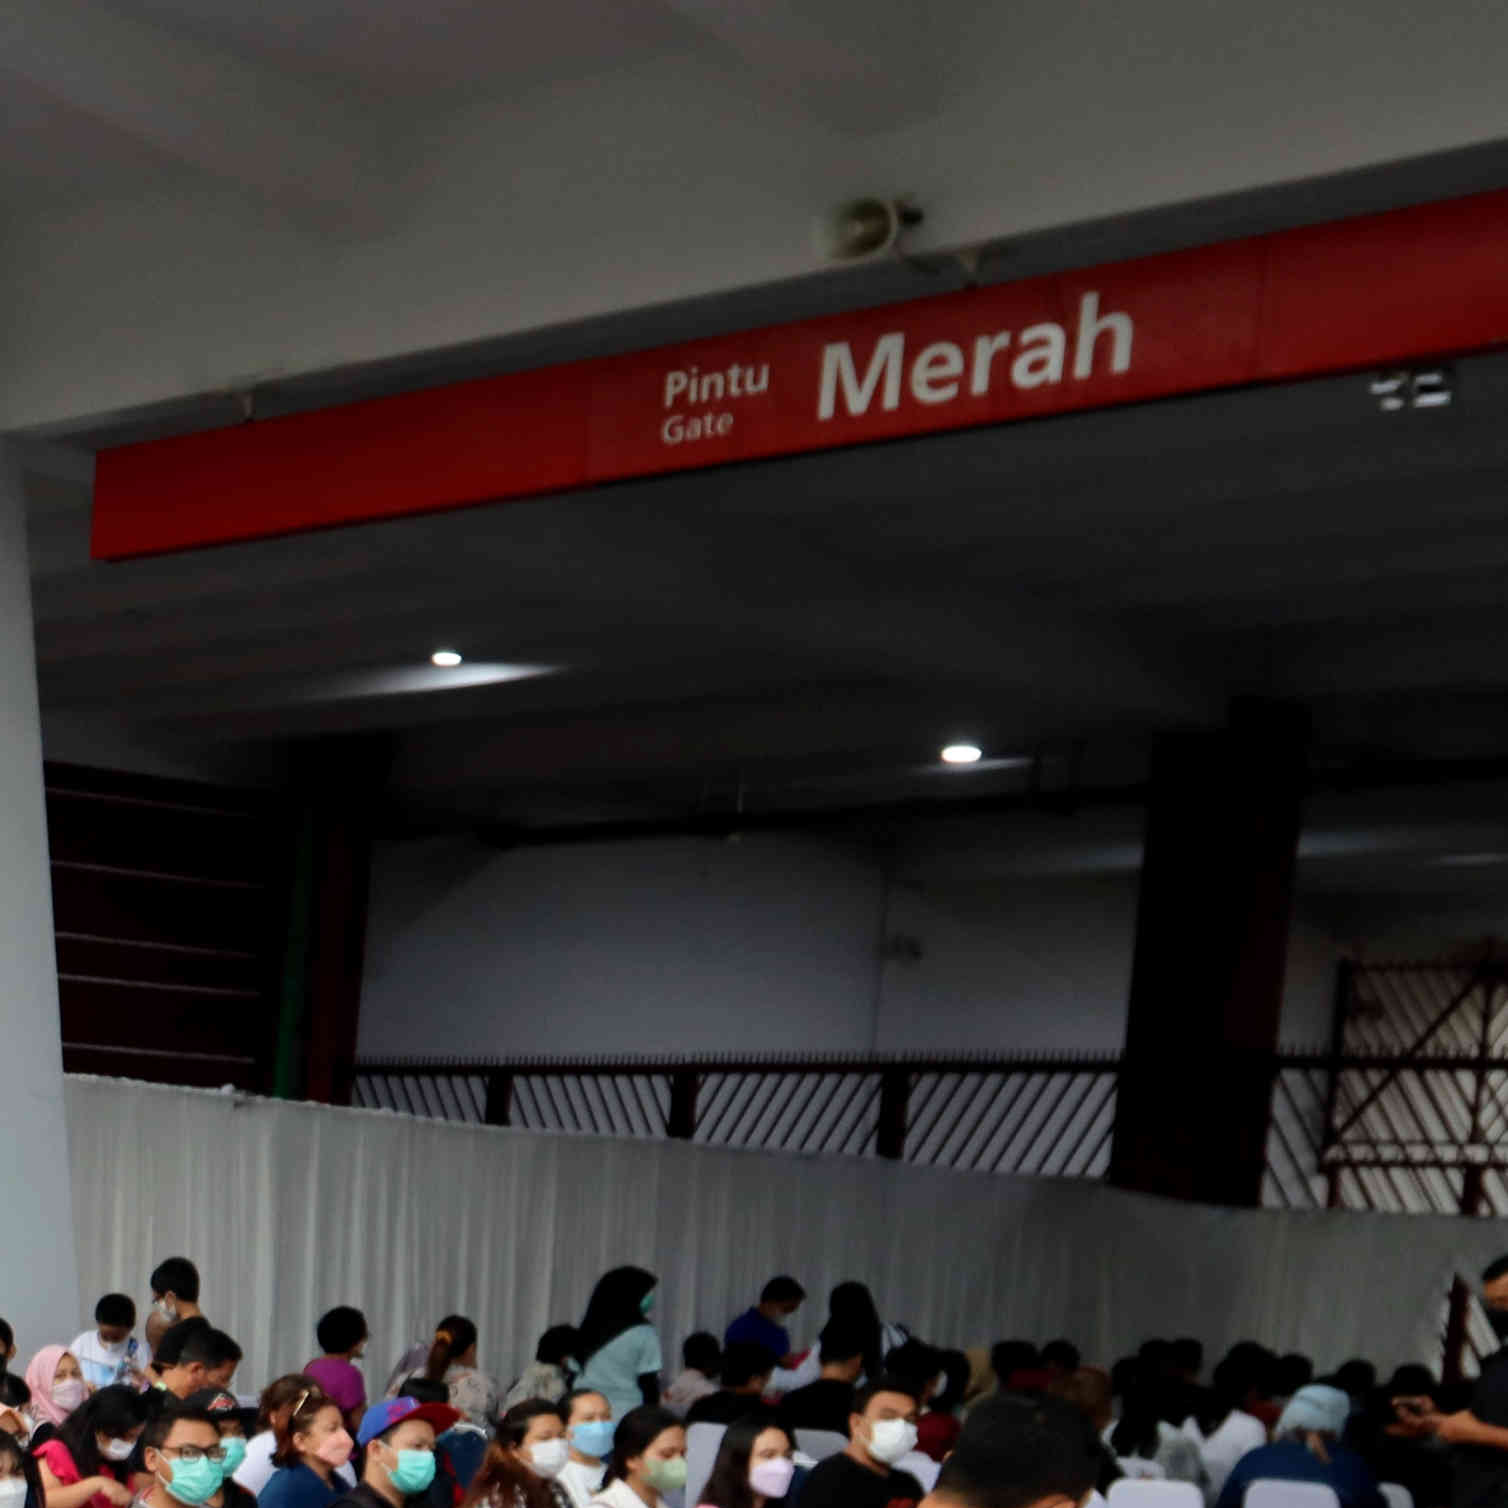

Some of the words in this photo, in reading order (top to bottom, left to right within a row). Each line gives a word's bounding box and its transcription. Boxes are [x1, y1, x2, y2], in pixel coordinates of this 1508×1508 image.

[817, 291, 1134, 422] Merah
[664, 362, 770, 408] Pintu
[663, 411, 735, 445] Gate
